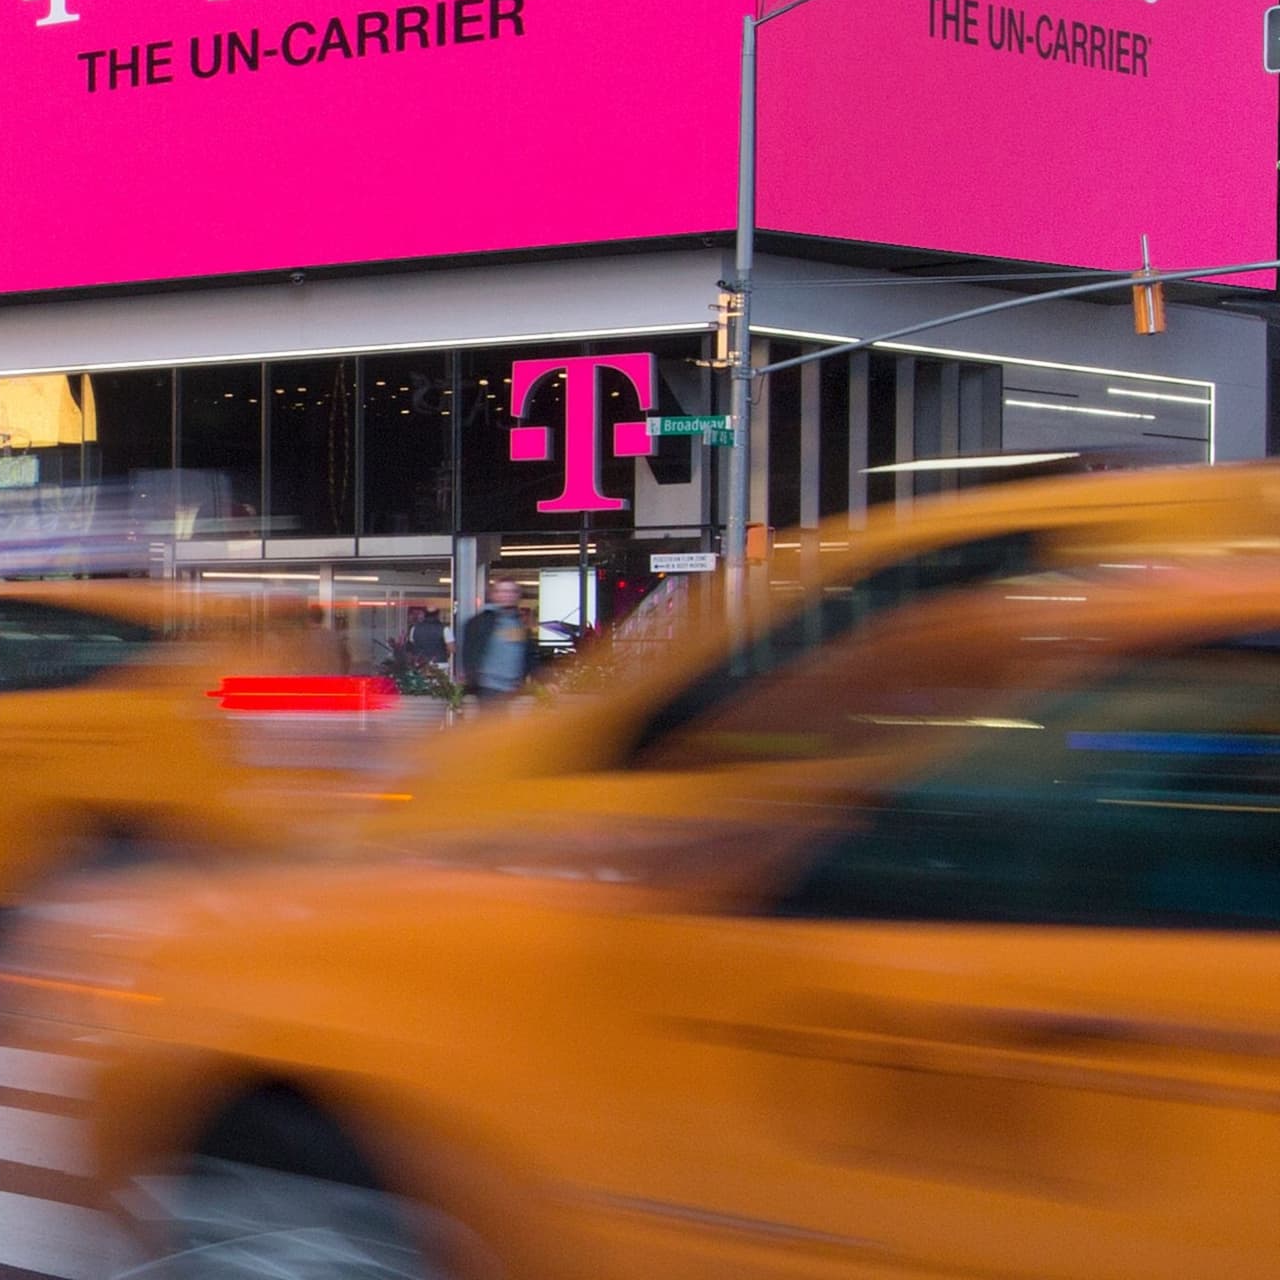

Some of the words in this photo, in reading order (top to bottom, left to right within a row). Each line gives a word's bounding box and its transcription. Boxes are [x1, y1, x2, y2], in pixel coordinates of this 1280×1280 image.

[78, 41, 173, 93] THE
[987, 4, 1151, 78] UN-CARRIER
[664, 418, 725, 432] Broadway
